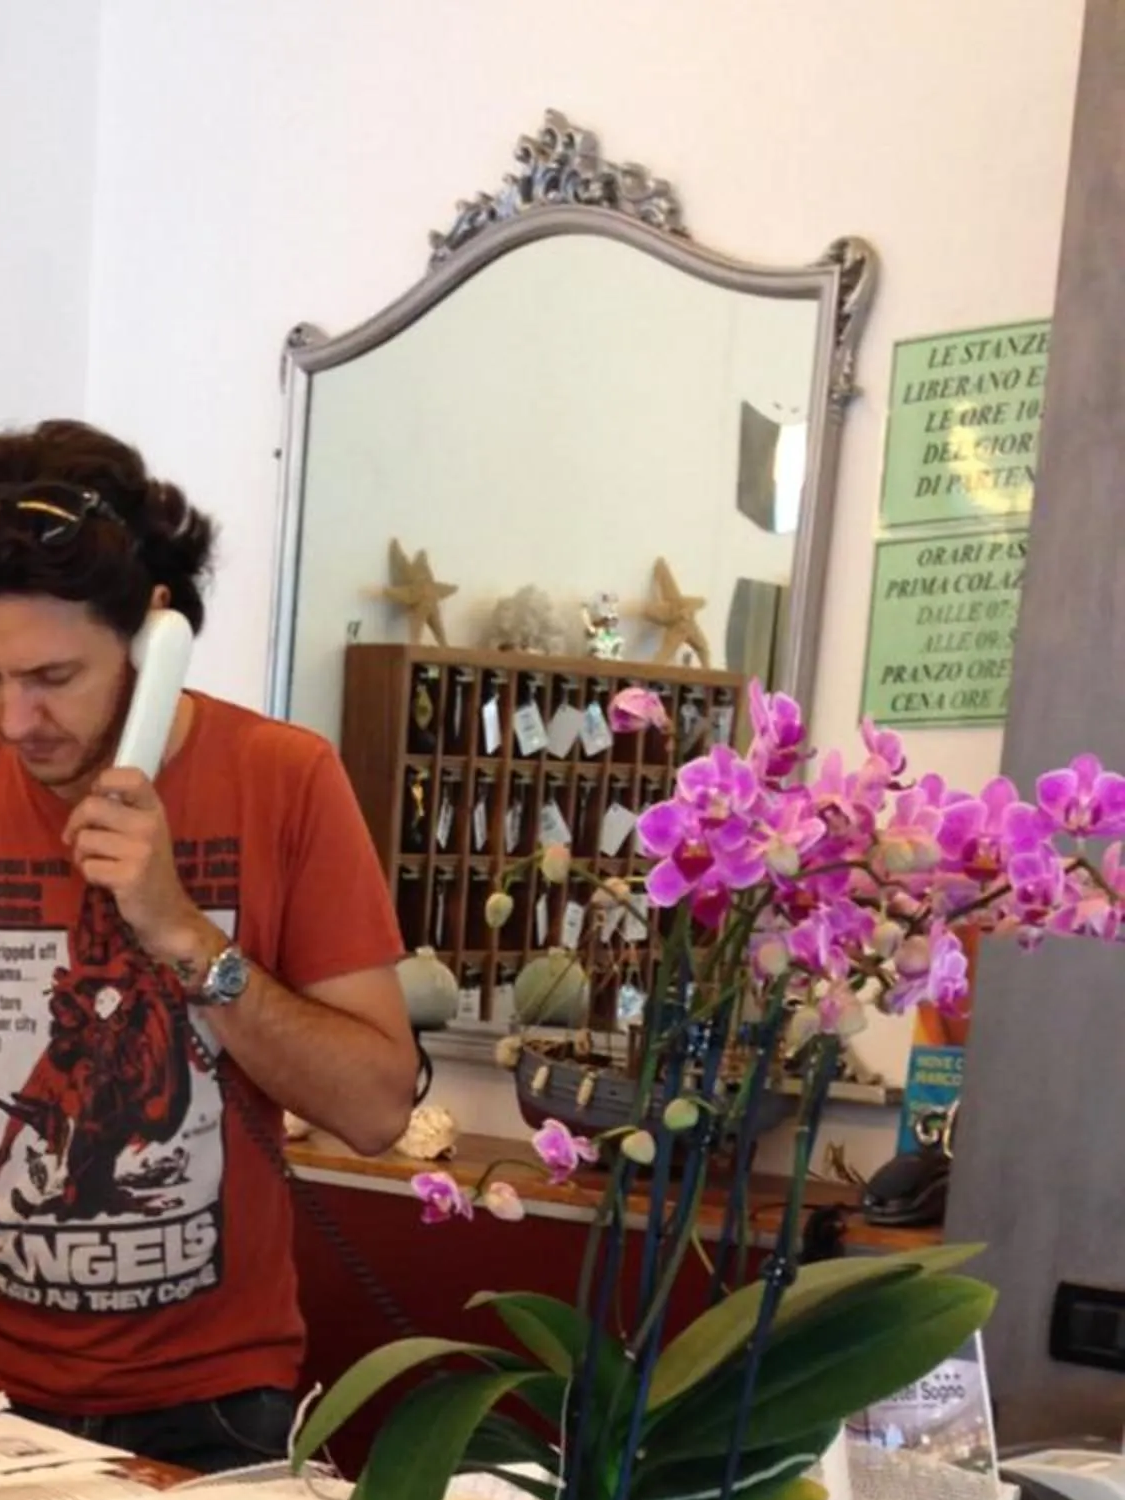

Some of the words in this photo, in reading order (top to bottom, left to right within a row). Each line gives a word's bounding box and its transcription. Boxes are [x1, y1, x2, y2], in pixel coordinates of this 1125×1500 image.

[928, 345, 957, 369] LE
[903, 367, 1020, 404] LIBERANO
[924, 409, 954, 433] LE
[959, 402, 1010, 427] ORE
[923, 441, 968, 465] DEL
[915, 474, 941, 498] DI
[916, 543, 983, 567] ORARI
[885, 576, 948, 600] PRIMA
[915, 602, 984, 625] DALLE
[919, 631, 973, 653] ALLE
[880, 661, 963, 685] PRANZO
[890, 690, 945, 713] CENA
[949, 687, 994, 710] ORE
[14, 1014, 37, 1035] city
[85, 1286, 153, 1312] THEY
[921, 1381, 966, 1404] Sogno
